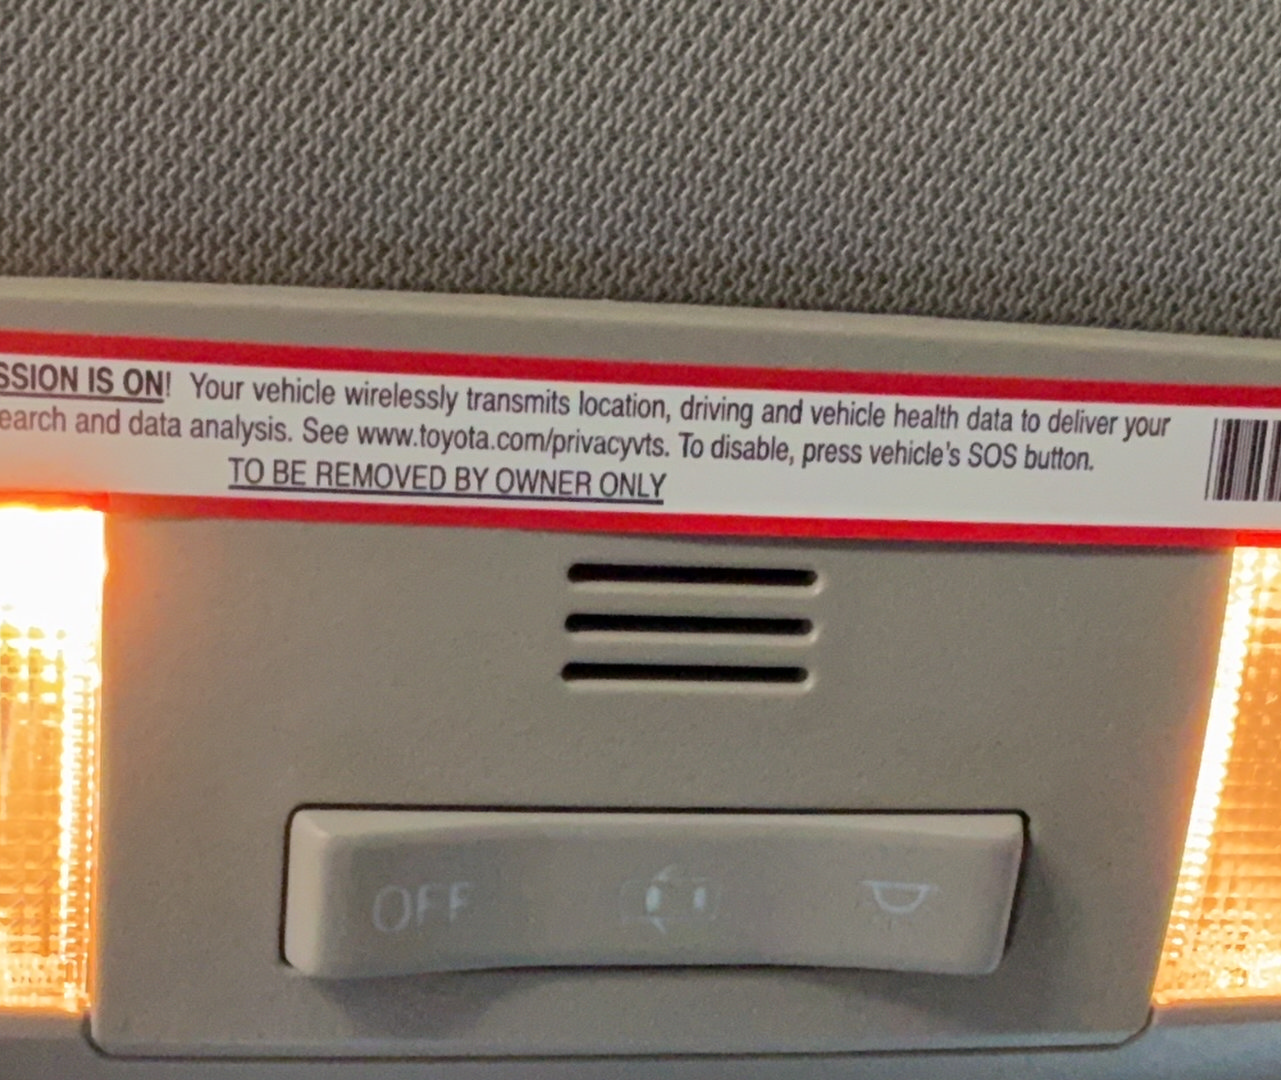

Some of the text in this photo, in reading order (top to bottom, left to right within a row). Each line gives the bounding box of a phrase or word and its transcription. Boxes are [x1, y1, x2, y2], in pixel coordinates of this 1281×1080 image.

[88, 366, 114, 395] IS
[123, 368, 171, 399] ON!
[190, 372, 244, 402] Your
[253, 376, 335, 406] vehicle
[345, 380, 460, 416] wirelessly
[466, 385, 570, 416] transmits
[579, 389, 671, 422] location,
[680, 393, 754, 427] driving
[761, 398, 803, 425] and
[811, 399, 886, 428] vehicle
[894, 402, 959, 431] health
[967, 405, 1013, 433] data
[1021, 409, 1040, 433] to
[1048, 408, 1118, 437] deliver
[1122, 414, 1171, 443] your
[76, 405, 120, 435] and
[128, 407, 182, 439] data
[190, 413, 293, 446] analysis.
[302, 417, 349, 445] See
[357, 422, 670, 460] www.toyota.com/privacyvts.
[677, 432, 705, 460] To
[711, 432, 795, 465] disable,
[802, 442, 862, 468] press
[869, 440, 960, 468] vehicle's
[967, 441, 1018, 469] SOS
[1024, 444, 1095, 473] button.
[228, 456, 668, 499] TO BE REMOVED BY OWNER ONLY
[371, 880, 473, 933] OFF
